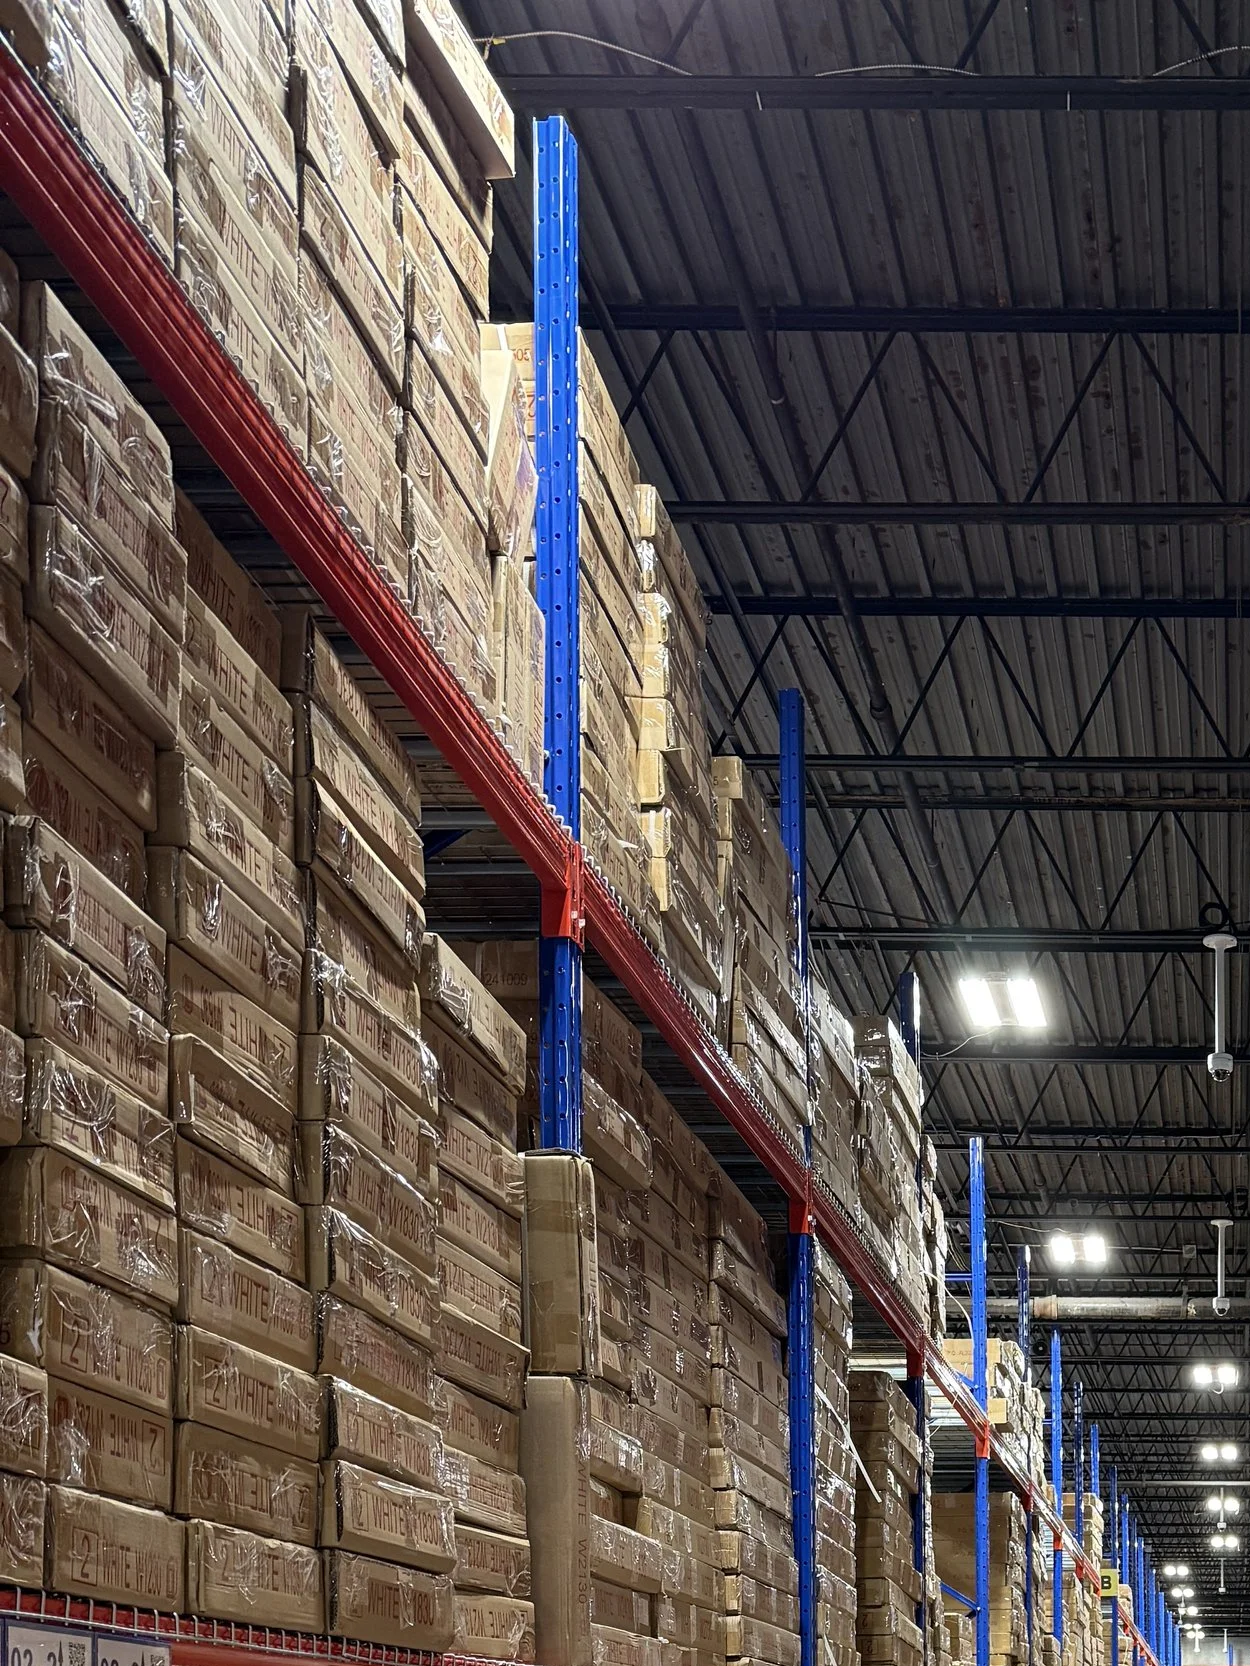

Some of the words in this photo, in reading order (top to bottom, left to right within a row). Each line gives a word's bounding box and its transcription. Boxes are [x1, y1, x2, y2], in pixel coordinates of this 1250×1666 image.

[206, 632, 249, 699] WHITE
[221, 907, 258, 975] WHITE
[229, 1005, 268, 1066] WHITE
[355, 1009, 389, 1061] WHITE
[390, 1031, 421, 1089] W1830
[357, 1167, 386, 1220] WHITE
[388, 1198, 421, 1243] W1830
[235, 1373, 274, 1423] WHITE
[401, 1435, 431, 1478] W1830
[371, 1496, 406, 1537] WHITE
[577, 1460, 588, 1526] WHITE
[367, 1577, 401, 1618] WHITE
[577, 1537, 589, 1604] W2130
